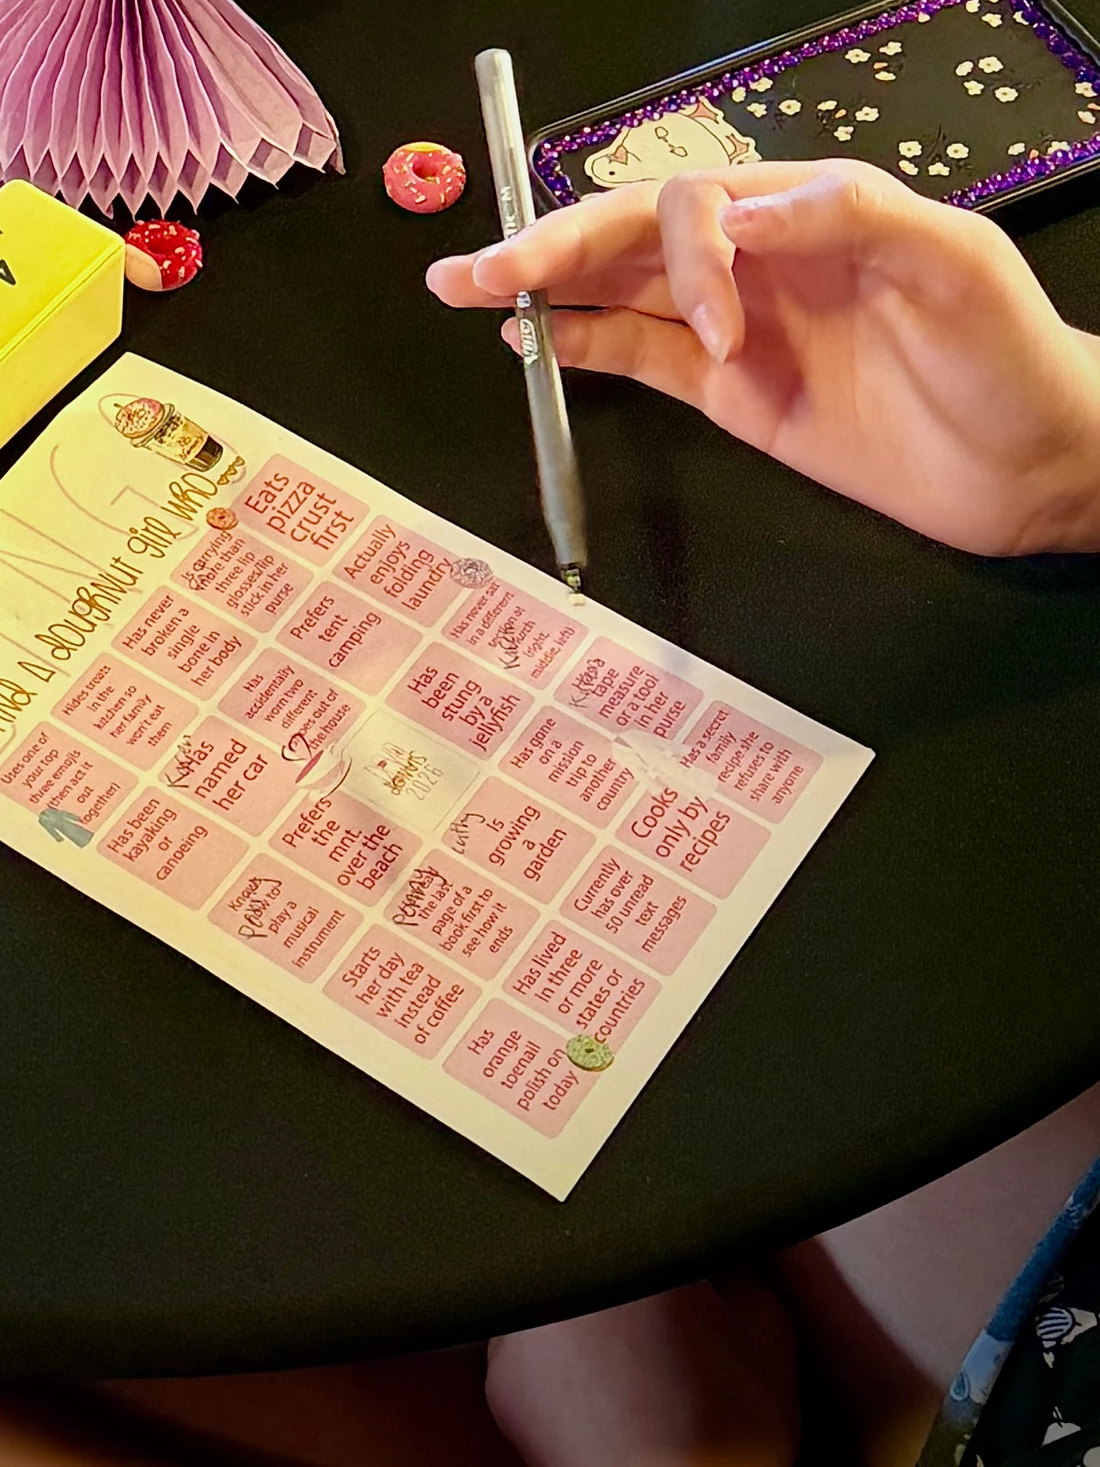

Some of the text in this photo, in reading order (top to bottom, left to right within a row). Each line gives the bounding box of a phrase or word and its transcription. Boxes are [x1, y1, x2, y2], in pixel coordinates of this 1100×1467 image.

[243, 472, 289, 513] Eats
[265, 481, 315, 533] pizza
[290, 492, 336, 542] crust
[310, 510, 354, 550] first
[289, 595, 334, 639] Prefers
[317, 614, 348, 642] tent
[328, 612, 381, 667] camping
[407, 666, 438, 694] Has
[420, 672, 459, 708] been
[441, 679, 482, 721] stung
[458, 689, 492, 726] by a
[468, 694, 520, 752] jellyfish
[193, 738, 247, 798] named
[212, 753, 267, 810] her car
[404, 762, 445, 802] 2026
[281, 795, 331, 847] Prefers
[310, 820, 340, 846] the
[485, 818, 504, 832] Is
[488, 805, 540, 866] growing
[630, 786, 678, 838] Cooks
[655, 795, 708, 857] only by
[337, 824, 390, 885] over the
[356, 843, 402, 889] beach
[521, 839, 536, 850] a
[523, 828, 566, 881] garden
[679, 810, 730, 872] recipes
[462, 902, 507, 957] see how it
[488, 925, 513, 953] ends
[341, 946, 380, 987] Starts
[355, 952, 404, 1004] her day
[512, 930, 566, 994] Has lived
[534, 949, 582, 1002] in three
[557, 959, 602, 1014] or more
[376, 962, 424, 1017] with tea
[394, 973, 441, 1028] instead
[414, 984, 464, 1044] of coffee
[575, 968, 622, 1029] states or
[586, 977, 645, 1044] countries
[467, 1029, 494, 1054] Has
[482, 1030, 521, 1077] orange
[500, 1040, 540, 1088] toenail
[516, 1048, 571, 1111] polish on
[541, 1069, 579, 1110] today
